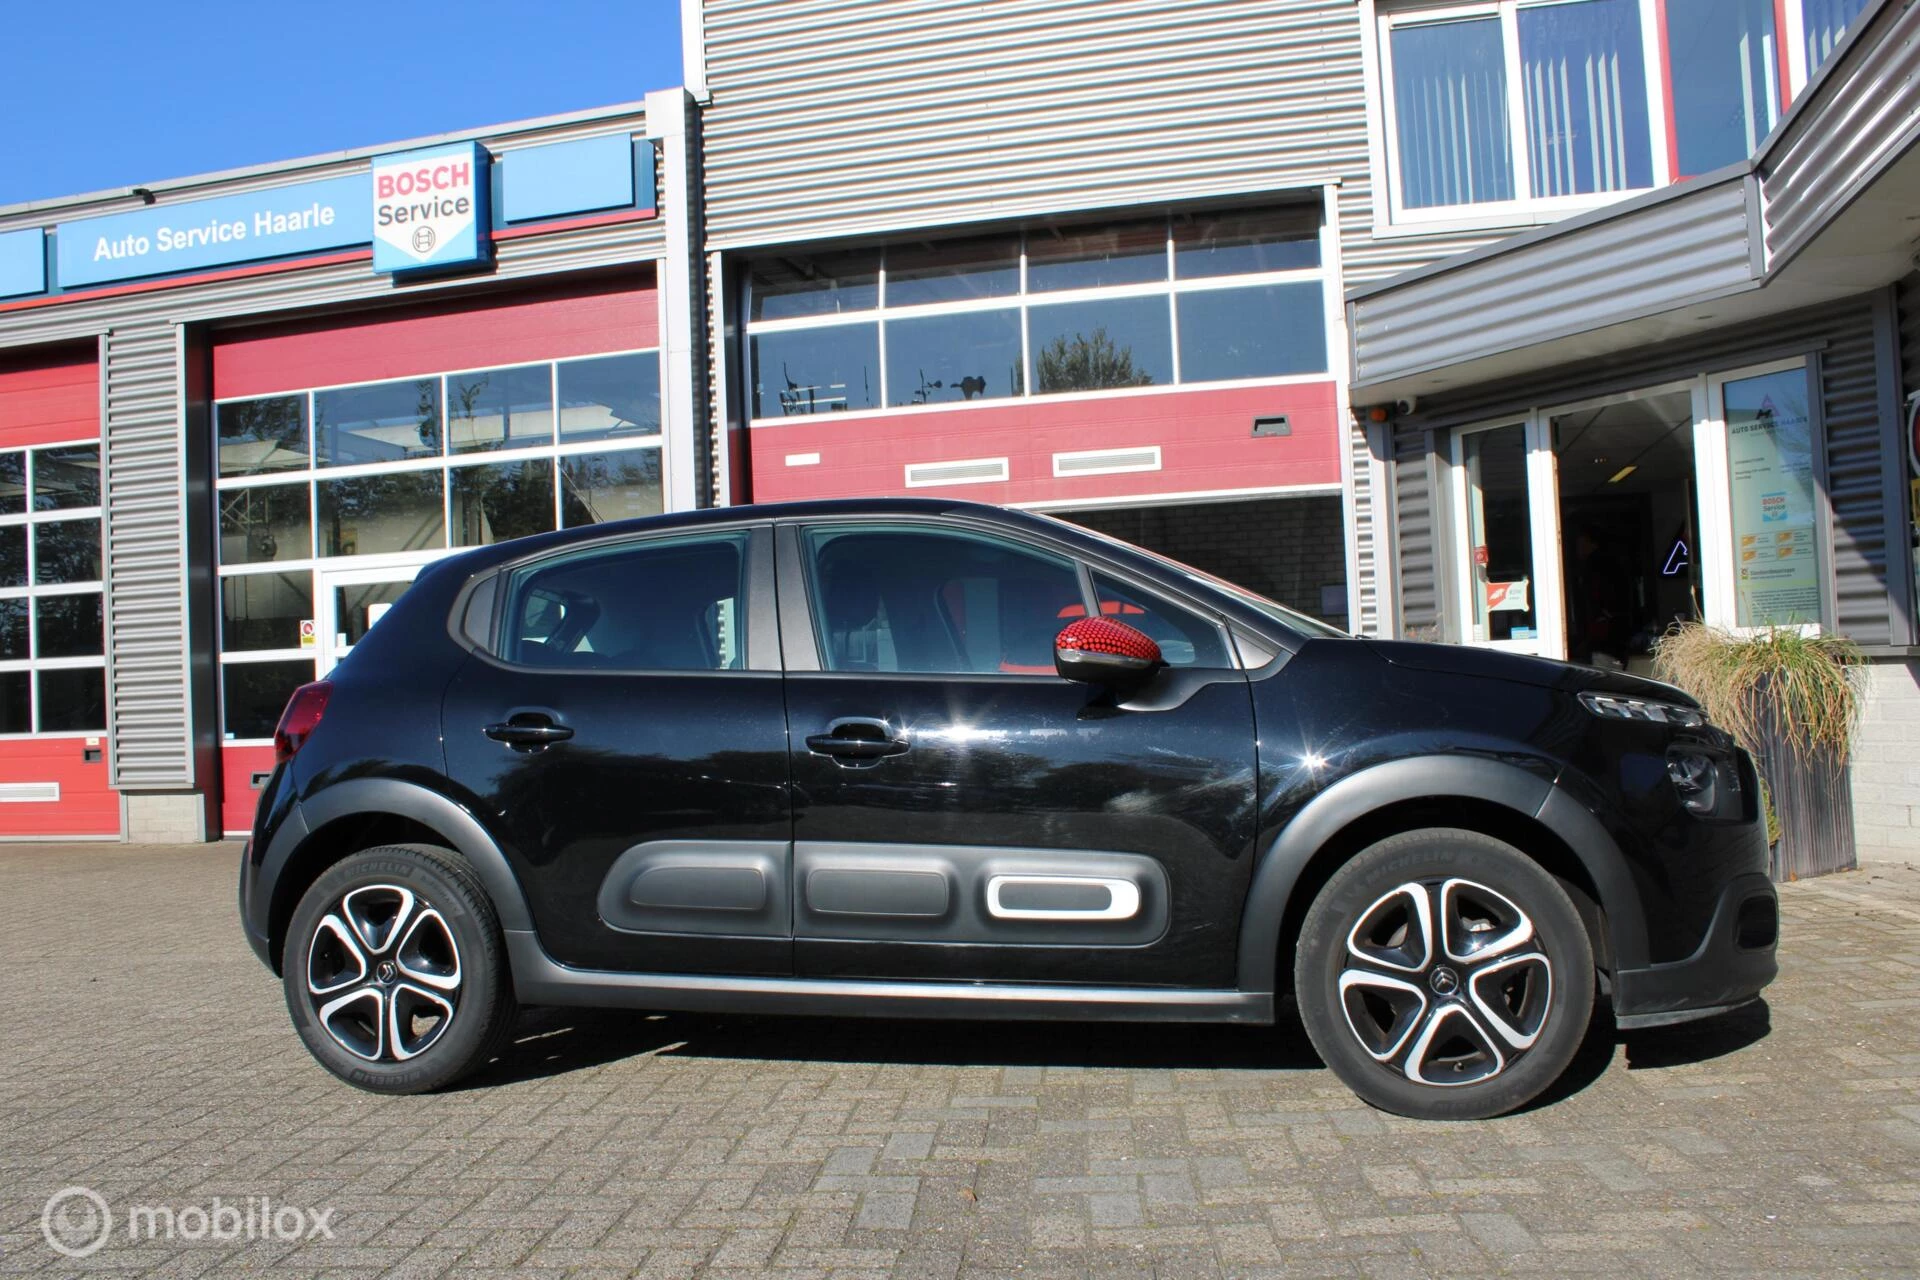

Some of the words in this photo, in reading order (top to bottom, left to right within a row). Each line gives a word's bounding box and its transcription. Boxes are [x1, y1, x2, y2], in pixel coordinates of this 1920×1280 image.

[378, 162, 469, 199] BOSCH
[378, 196, 469, 226] Service
[93, 233, 149, 262] Auto
[156, 219, 247, 252] Service
[254, 202, 336, 237] Haarle
[1731, 425, 1749, 435] AUTO
[1762, 496, 1785, 505] BOSCH
[345, 861, 411, 878] MICHELIN
